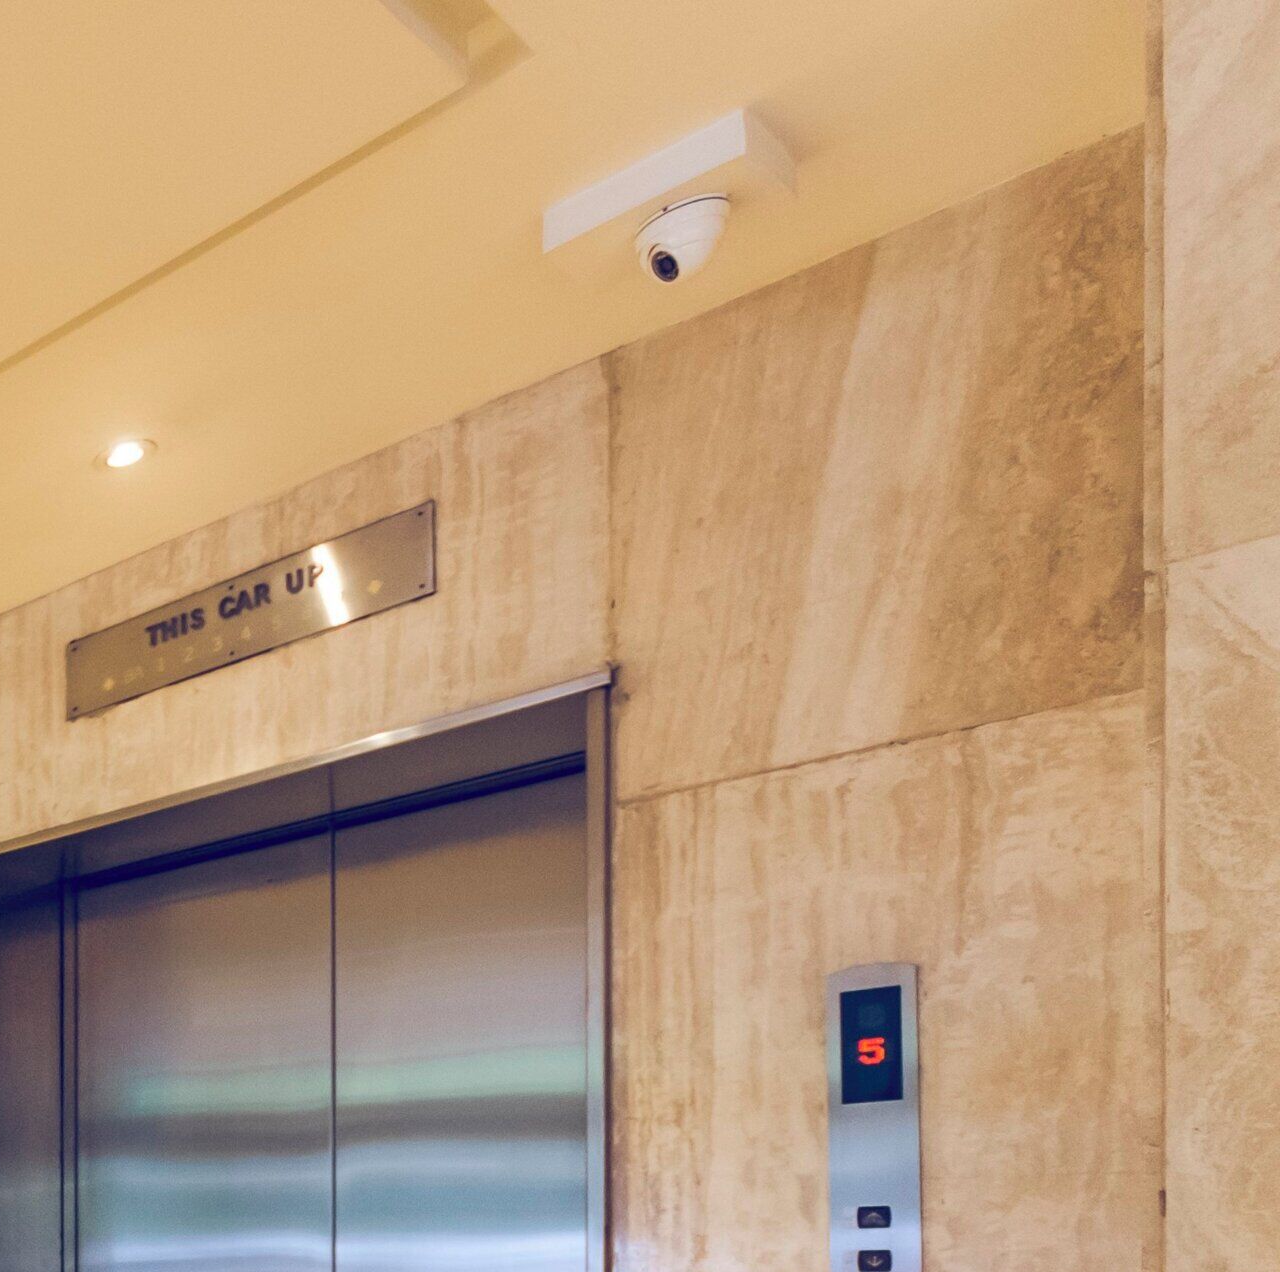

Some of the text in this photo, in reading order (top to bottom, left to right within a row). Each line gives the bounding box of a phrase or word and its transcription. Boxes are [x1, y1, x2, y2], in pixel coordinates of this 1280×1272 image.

[145, 564, 323, 647] THIS CAR UP
[857, 1037, 885, 1065] 5
